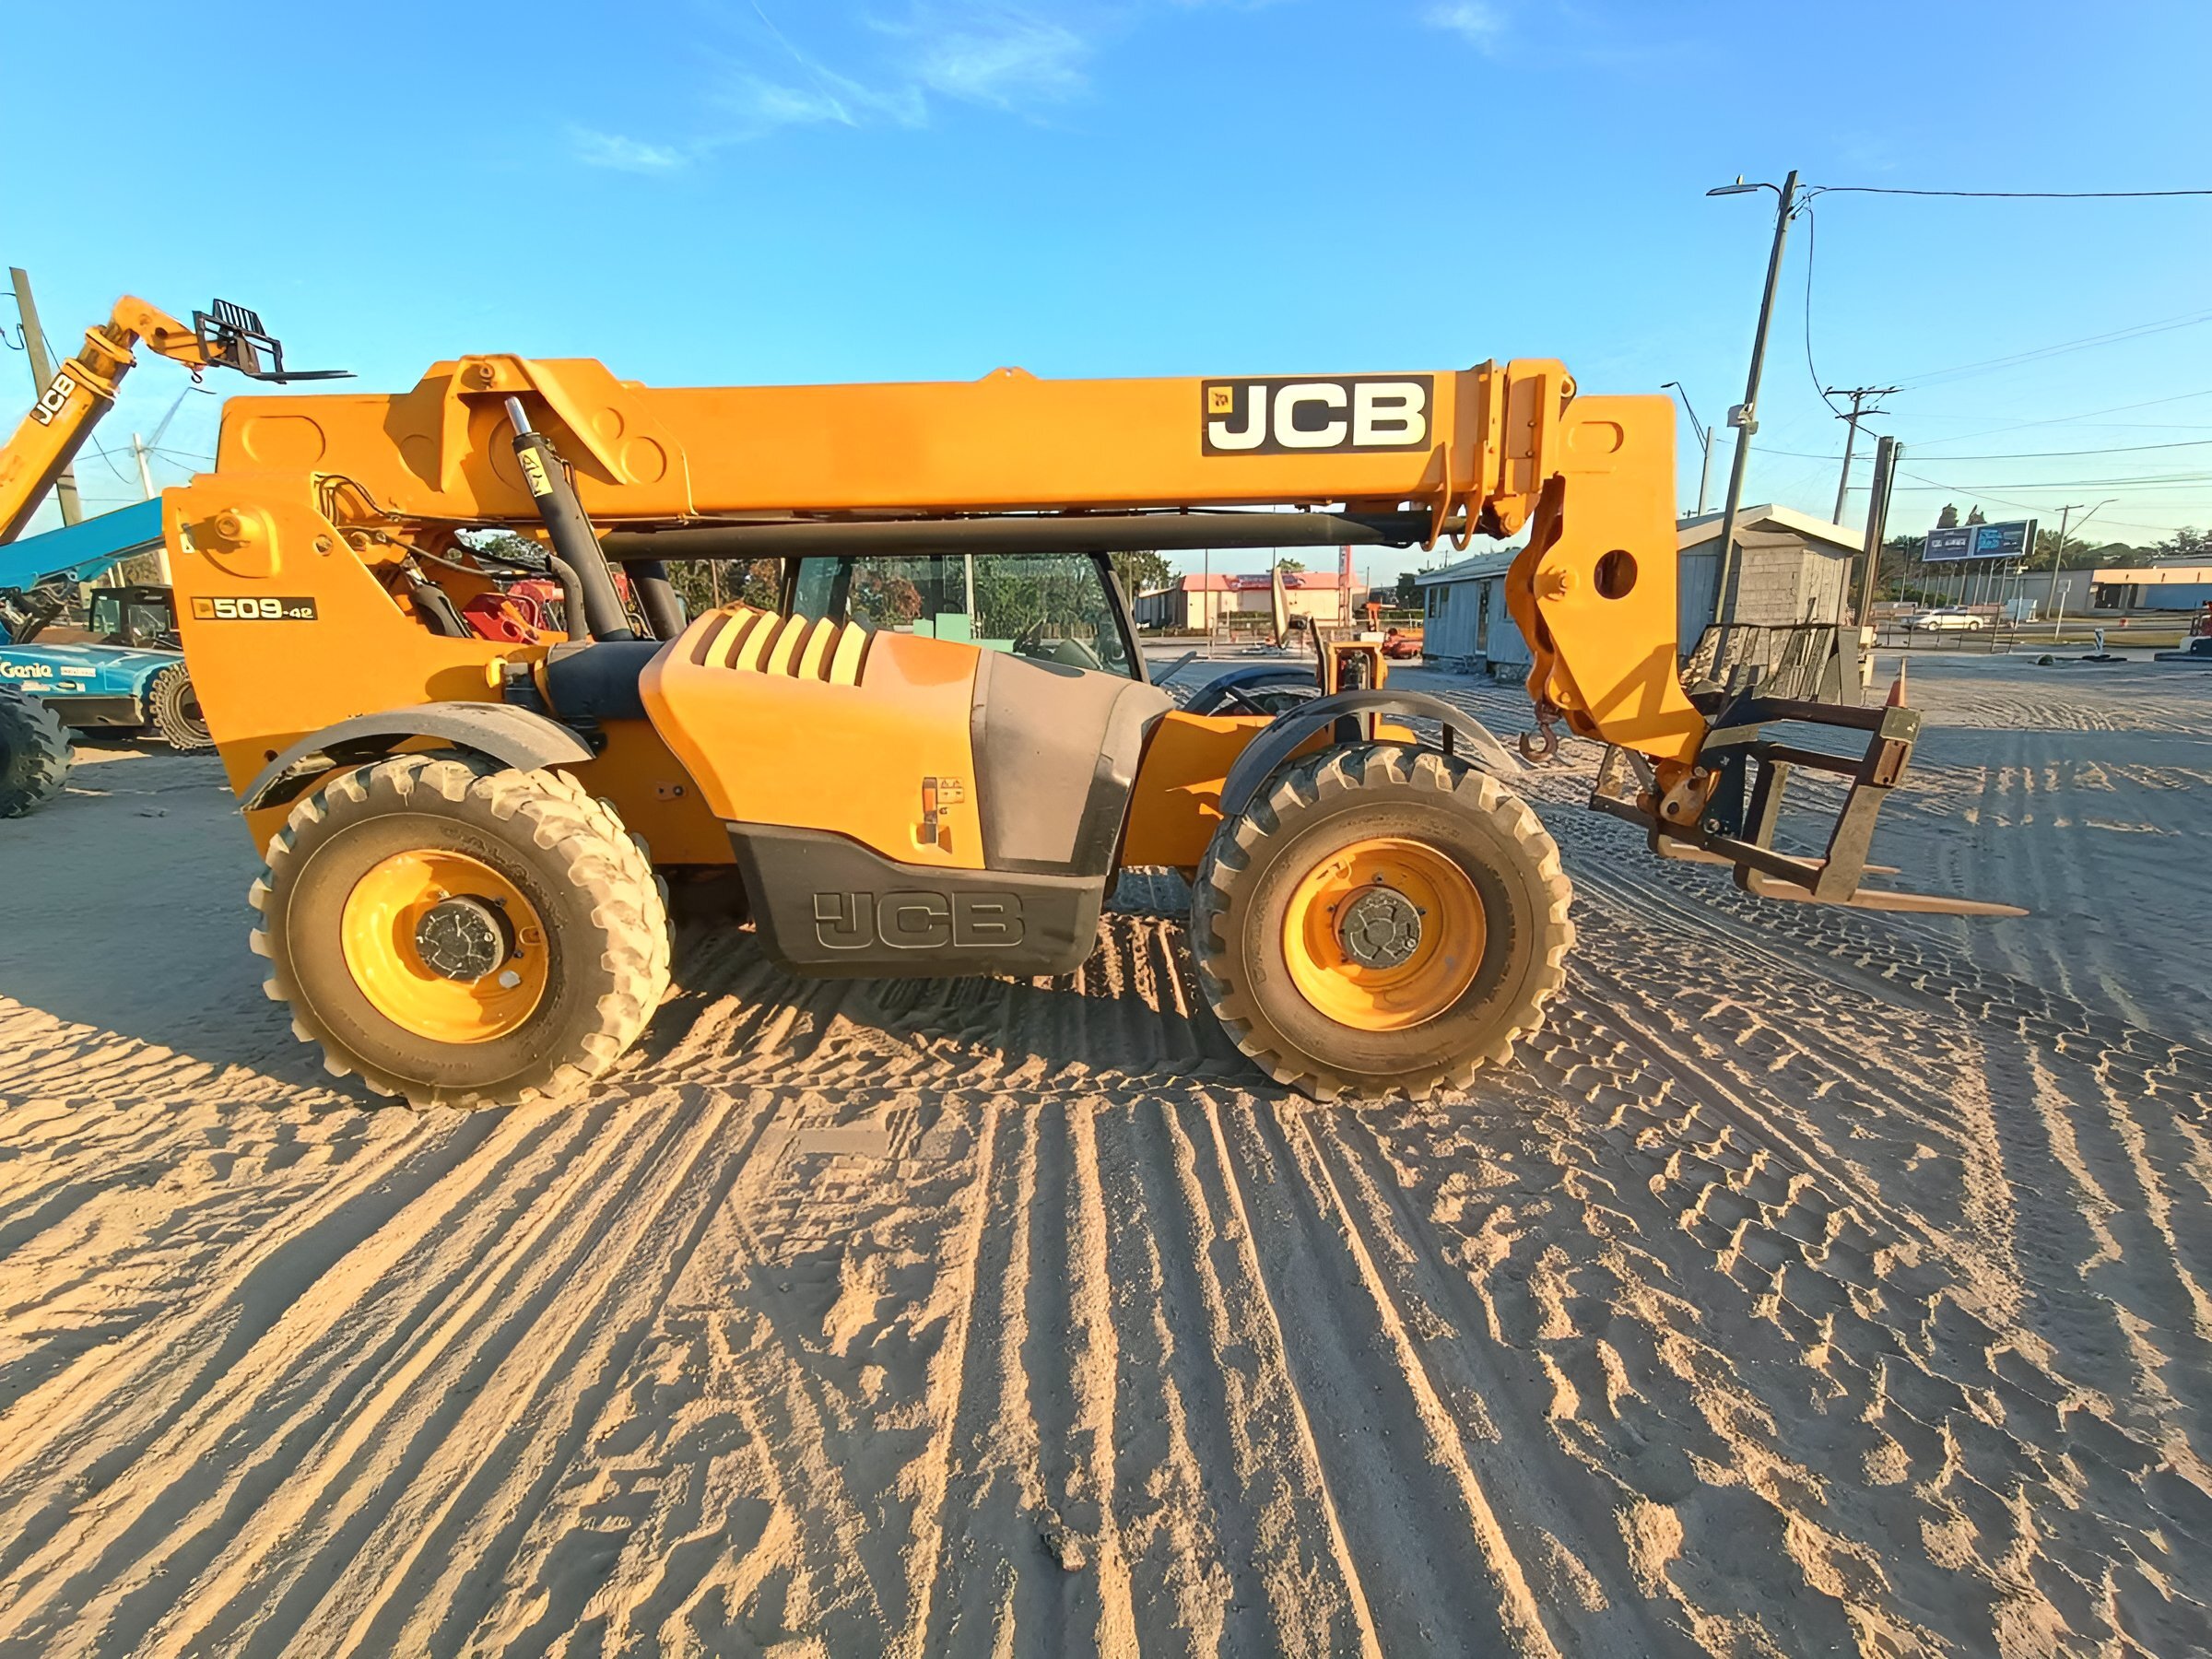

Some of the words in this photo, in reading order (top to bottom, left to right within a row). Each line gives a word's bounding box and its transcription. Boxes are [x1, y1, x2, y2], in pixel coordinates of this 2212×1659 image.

[36, 373, 76, 425] JCB
[1208, 382, 1426, 450] JCB
[213, 598, 314, 618] 509-42
[814, 890, 1026, 949] JCB
